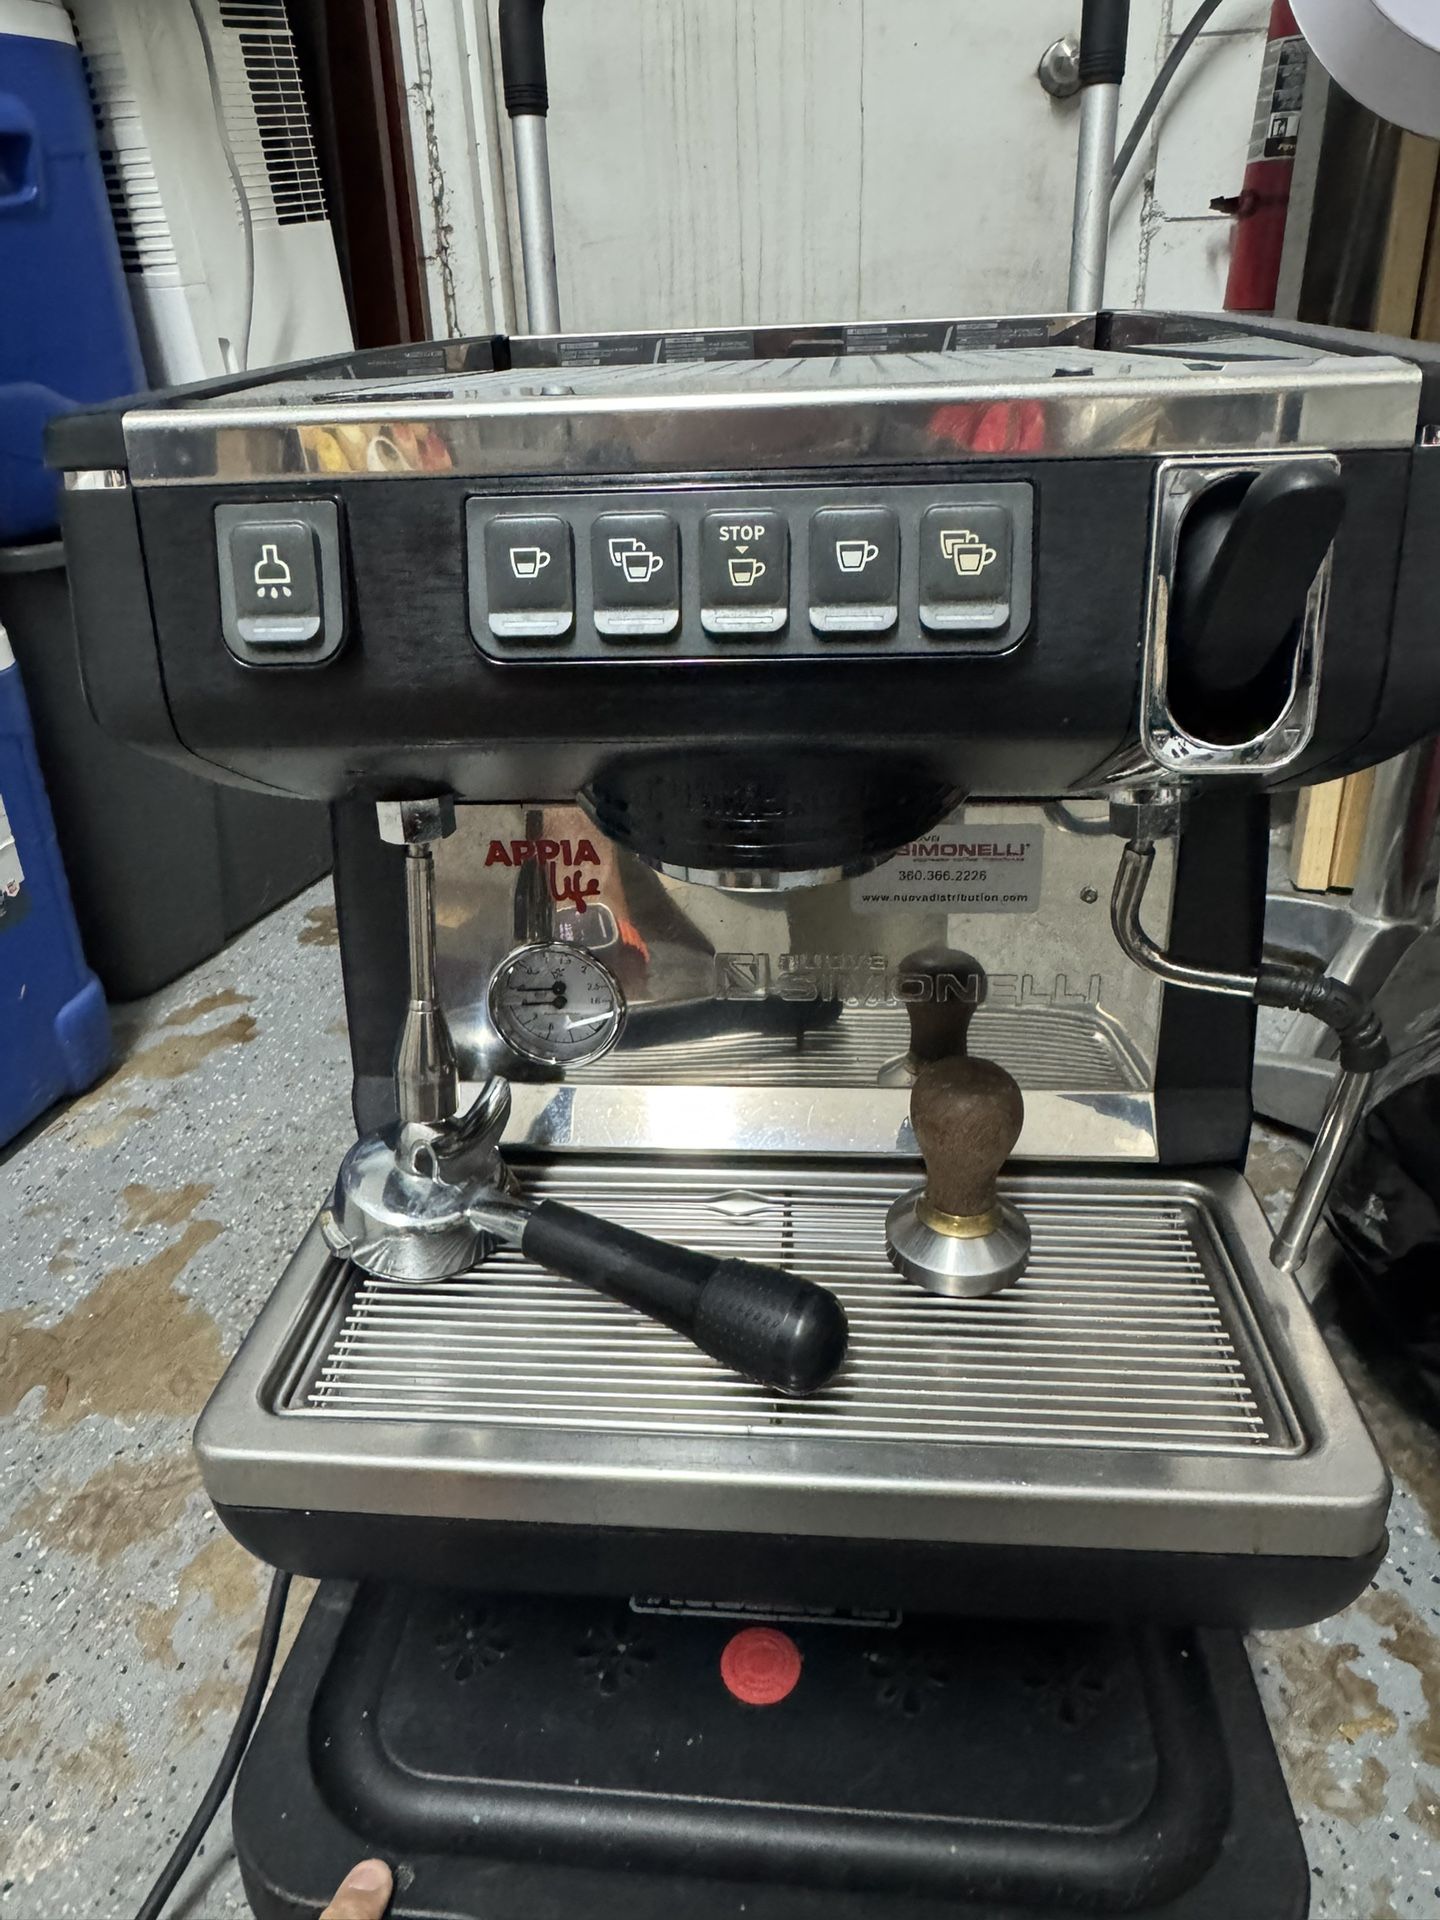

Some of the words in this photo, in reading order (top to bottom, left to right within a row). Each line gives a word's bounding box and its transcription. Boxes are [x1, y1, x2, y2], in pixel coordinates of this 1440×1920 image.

[719, 525, 765, 541] STOP
[485, 839, 601, 867] APPIA
[898, 870, 987, 881] 360.366.2226
[862, 892, 1028, 902] www.nuovadistribution.com
